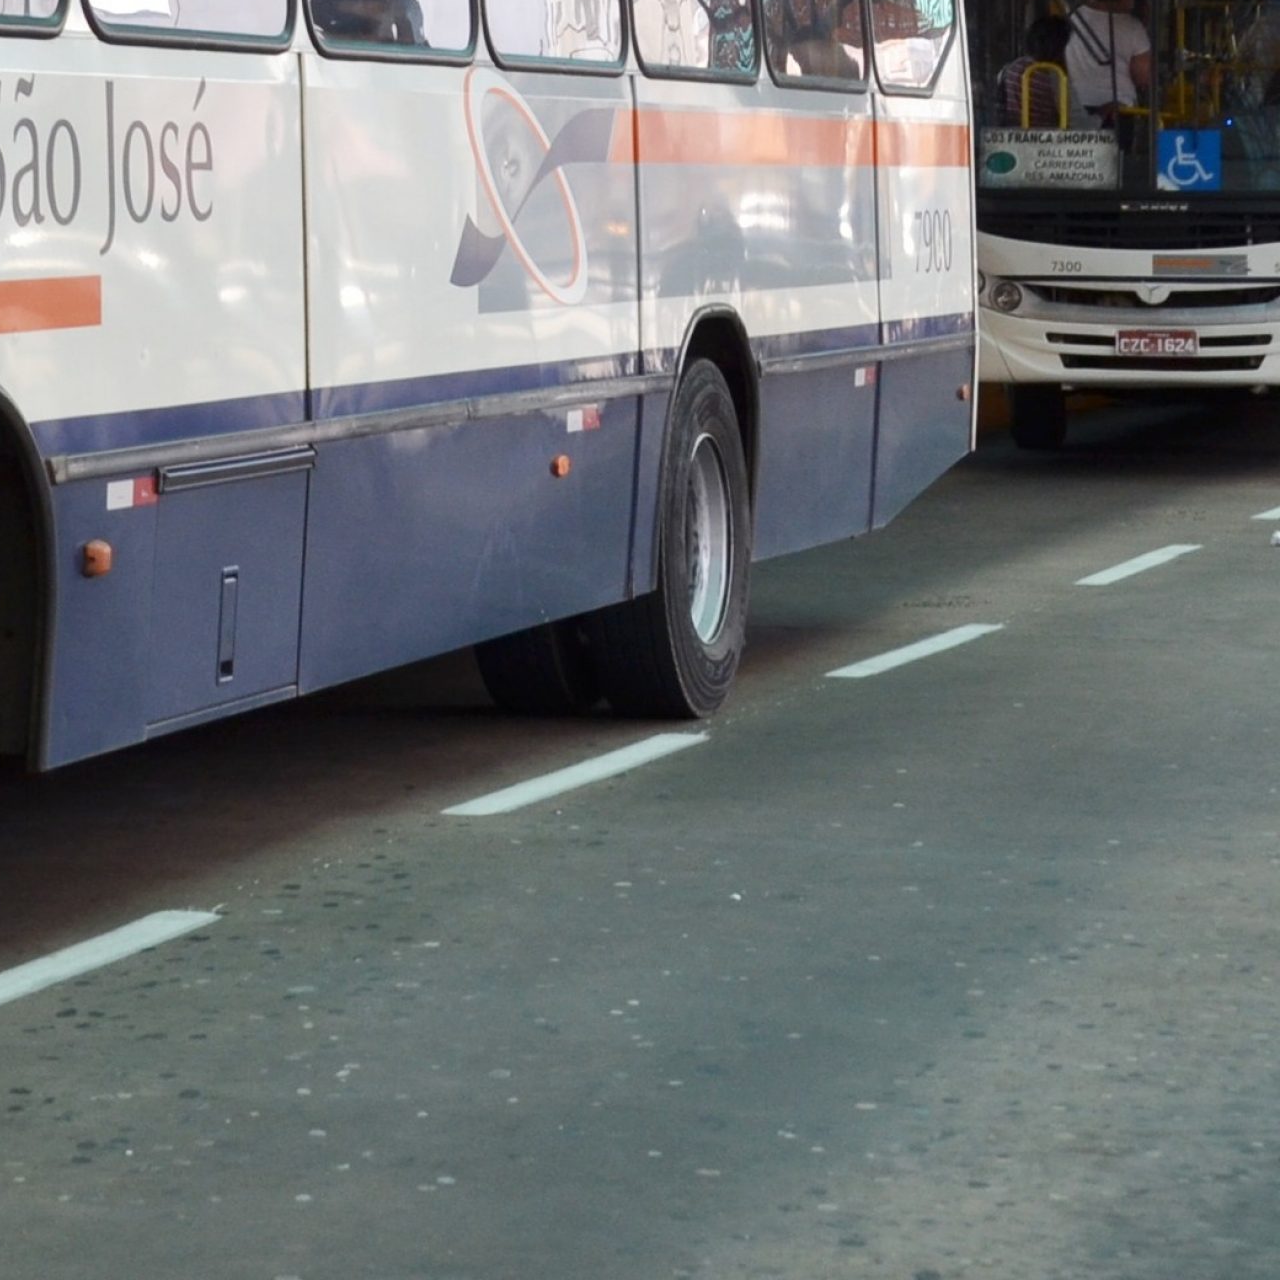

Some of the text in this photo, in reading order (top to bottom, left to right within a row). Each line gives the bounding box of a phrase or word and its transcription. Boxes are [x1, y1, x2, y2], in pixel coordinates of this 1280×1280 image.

[1008, 130, 1053, 144] FRANCA
[100, 77, 214, 255] José
[1034, 161, 1096, 170] CARREFOUR
[1049, 172, 1105, 181] AMAZONAS
[914, 209, 952, 273] 7900
[1051, 261, 1082, 272] 7300
